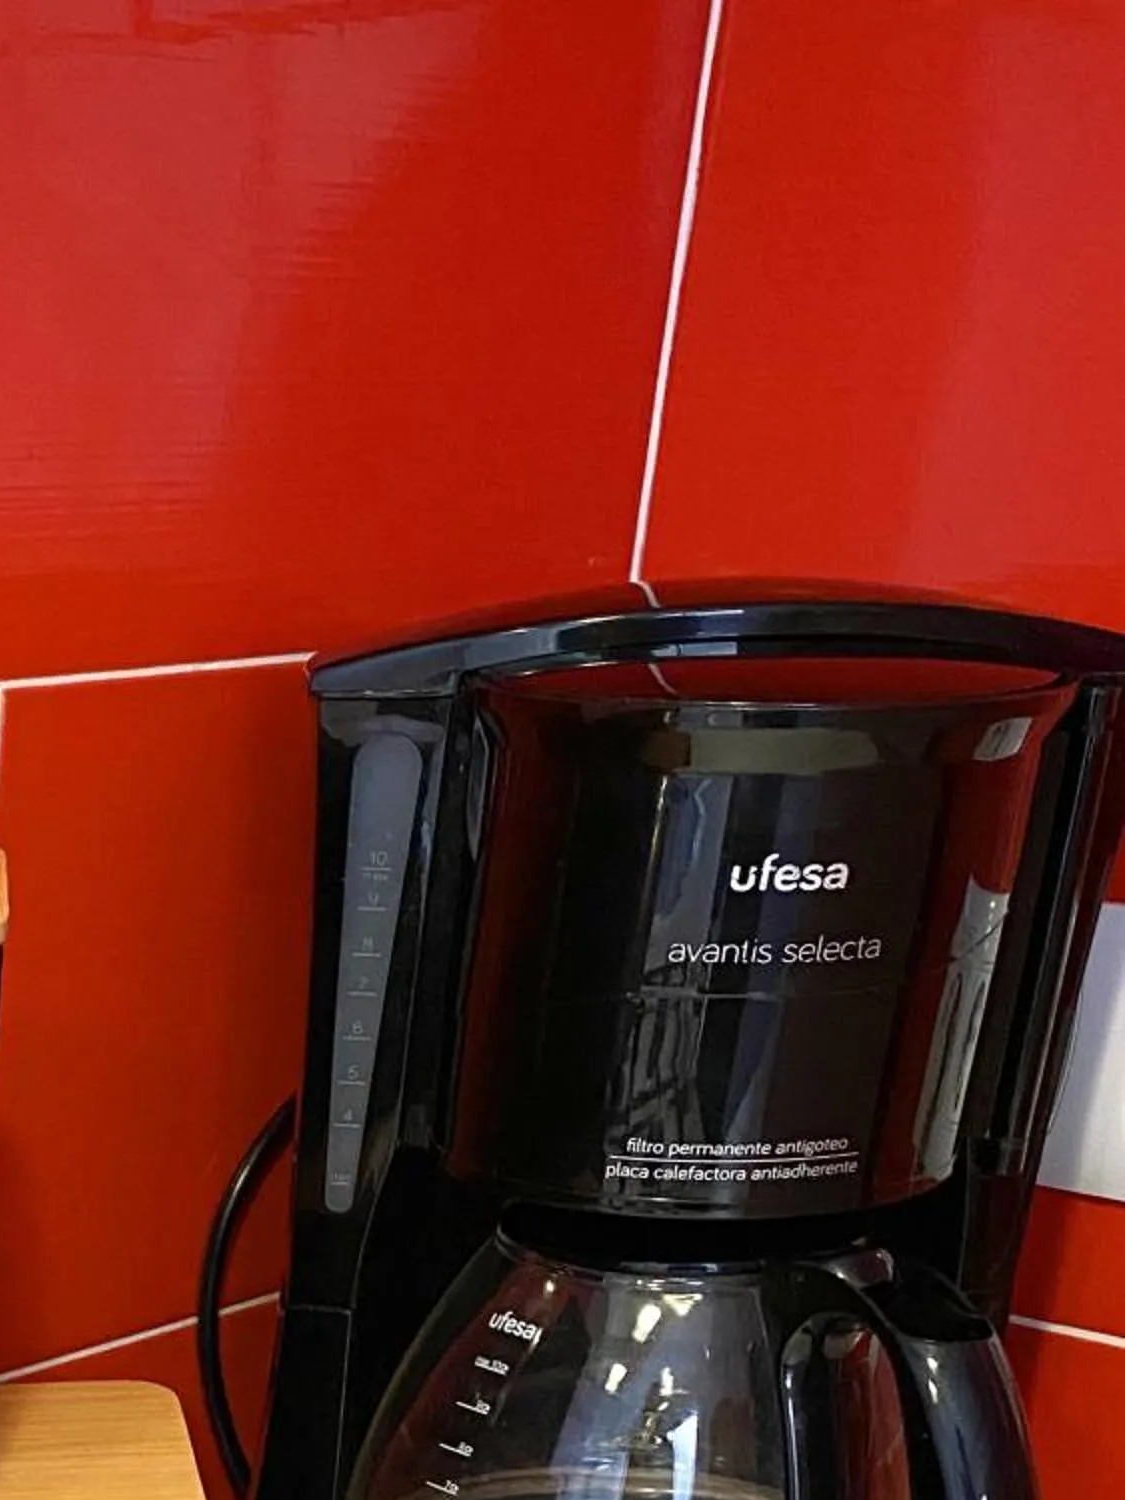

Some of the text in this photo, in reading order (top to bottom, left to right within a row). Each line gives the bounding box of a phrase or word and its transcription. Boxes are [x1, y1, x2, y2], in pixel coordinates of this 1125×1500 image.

[730, 853, 849, 892] ufesa
[667, 934, 882, 964] avantis selecta
[626, 1137, 848, 1157] filtro permanente antigoteo
[605, 1160, 858, 1180] placa calefactora antiadherente
[488, 1311, 536, 1340] ufesa
